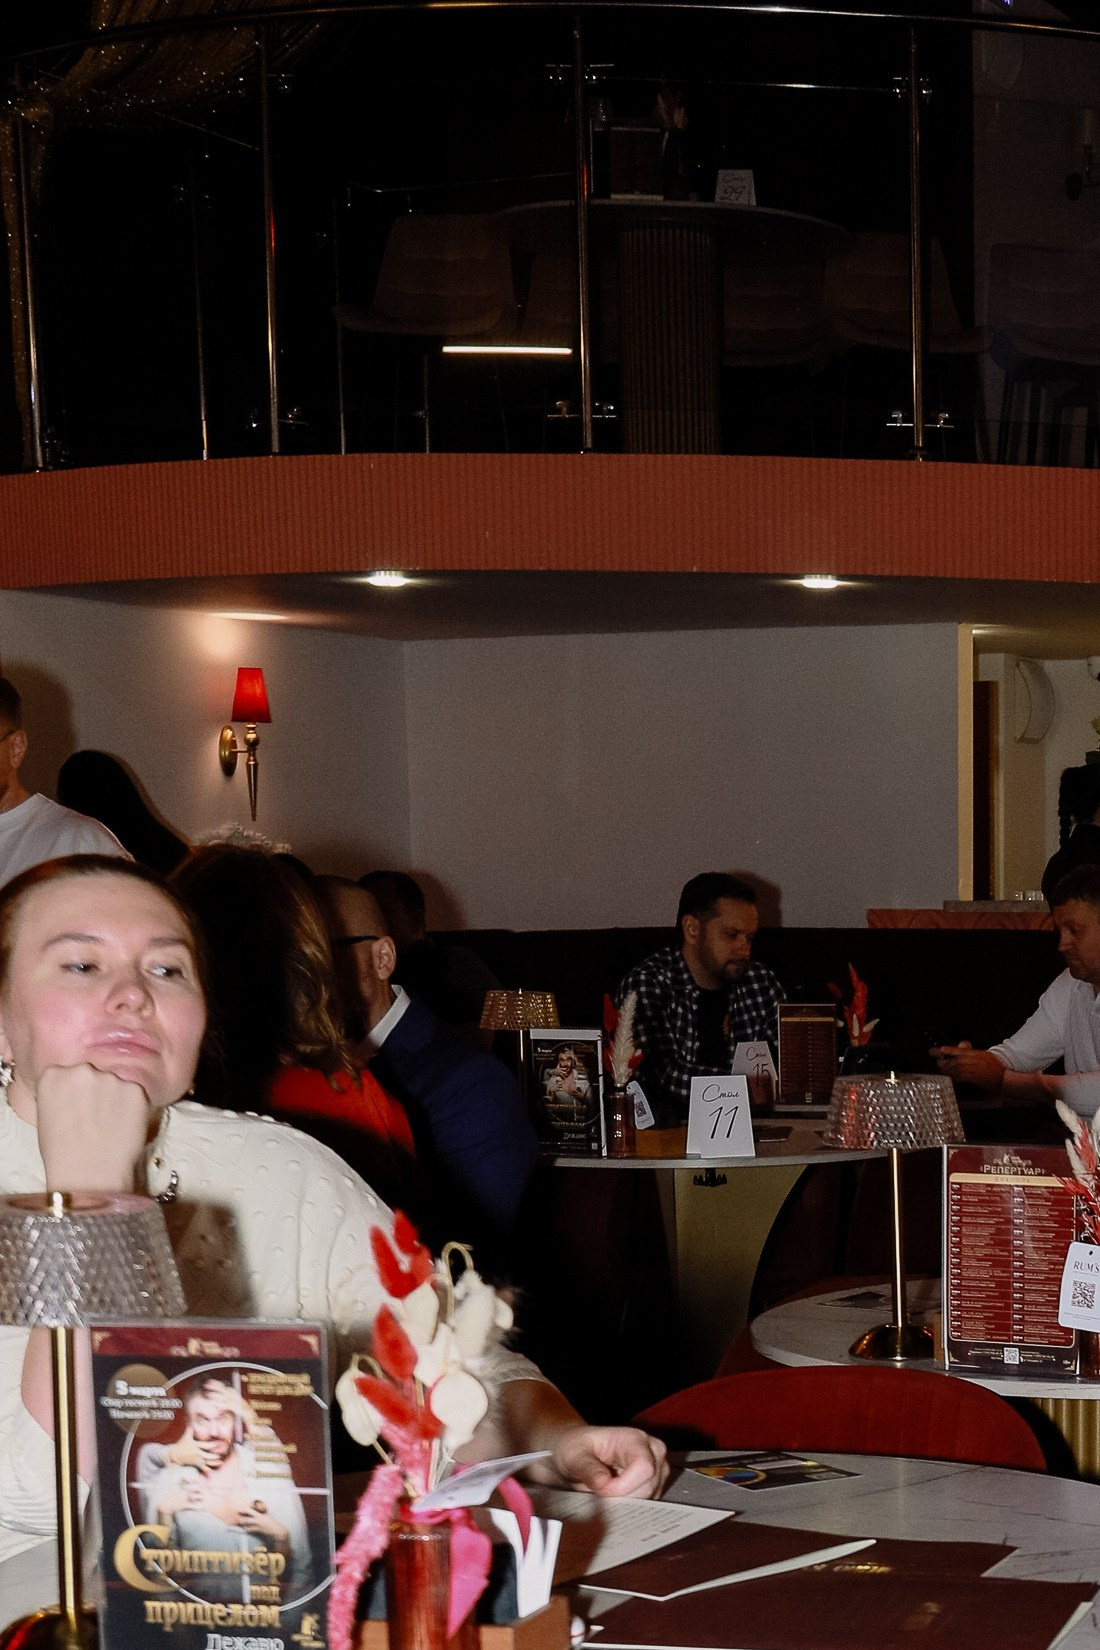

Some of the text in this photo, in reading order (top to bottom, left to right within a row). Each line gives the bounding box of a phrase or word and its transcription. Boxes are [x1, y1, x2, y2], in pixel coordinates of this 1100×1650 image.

[702, 1084, 740, 1102] Стол
[709, 1105, 739, 1139] 11
[113, 1523, 286, 1594] Стриптизёр
[144, 1600, 282, 1632] прицелом
